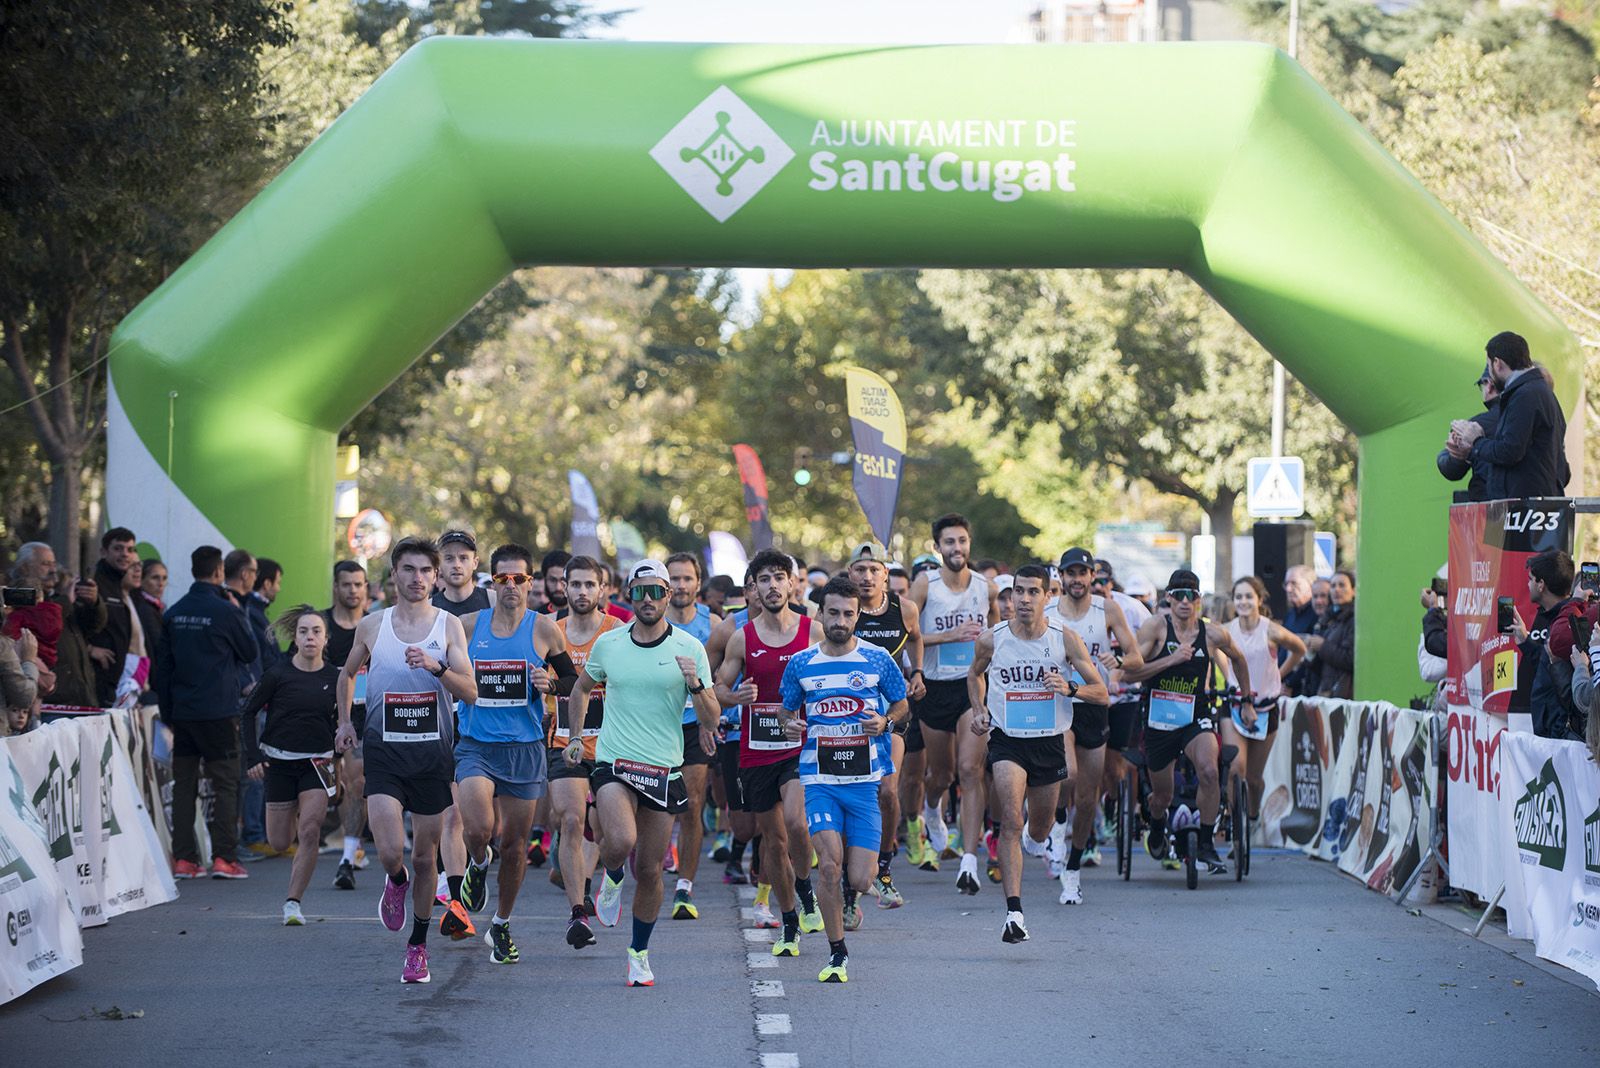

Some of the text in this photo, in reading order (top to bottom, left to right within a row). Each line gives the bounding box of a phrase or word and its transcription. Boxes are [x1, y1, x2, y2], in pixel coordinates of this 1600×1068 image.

[810, 119, 1077, 148] AJUNTAMENT DE
[807, 151, 1077, 202] SantCugat
[480, 675, 522, 684] JORGE JUAN
[820, 700, 854, 714] DANI
[759, 718, 779, 727] FERNA
[832, 750, 855, 761] JOSEP
[842, 761, 847, 769] 1
